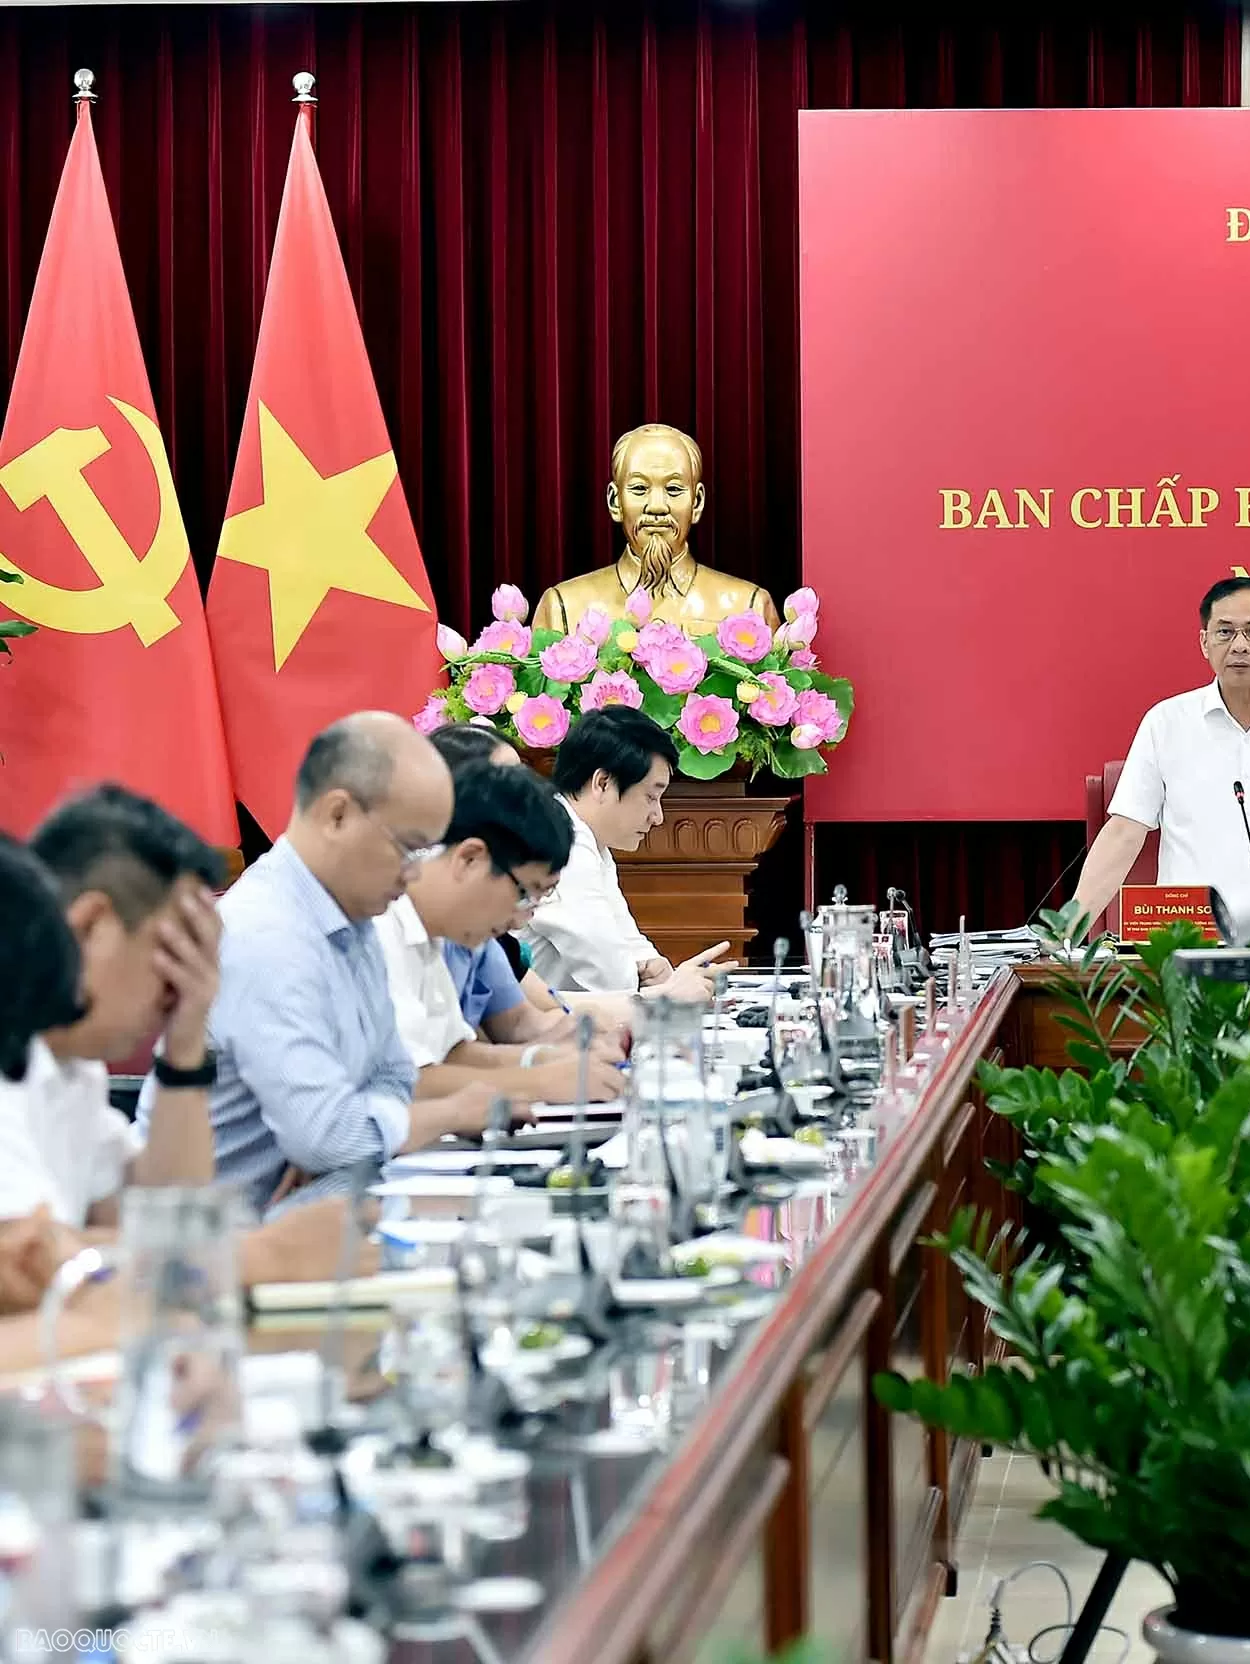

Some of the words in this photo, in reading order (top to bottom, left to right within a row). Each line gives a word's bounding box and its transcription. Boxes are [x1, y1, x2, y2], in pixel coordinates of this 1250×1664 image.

[938, 488, 1055, 529] BAN
[1070, 474, 1220, 529] CHẤP
[1134, 904, 1153, 914] BÙI
[1156, 905, 1194, 914] THANH
